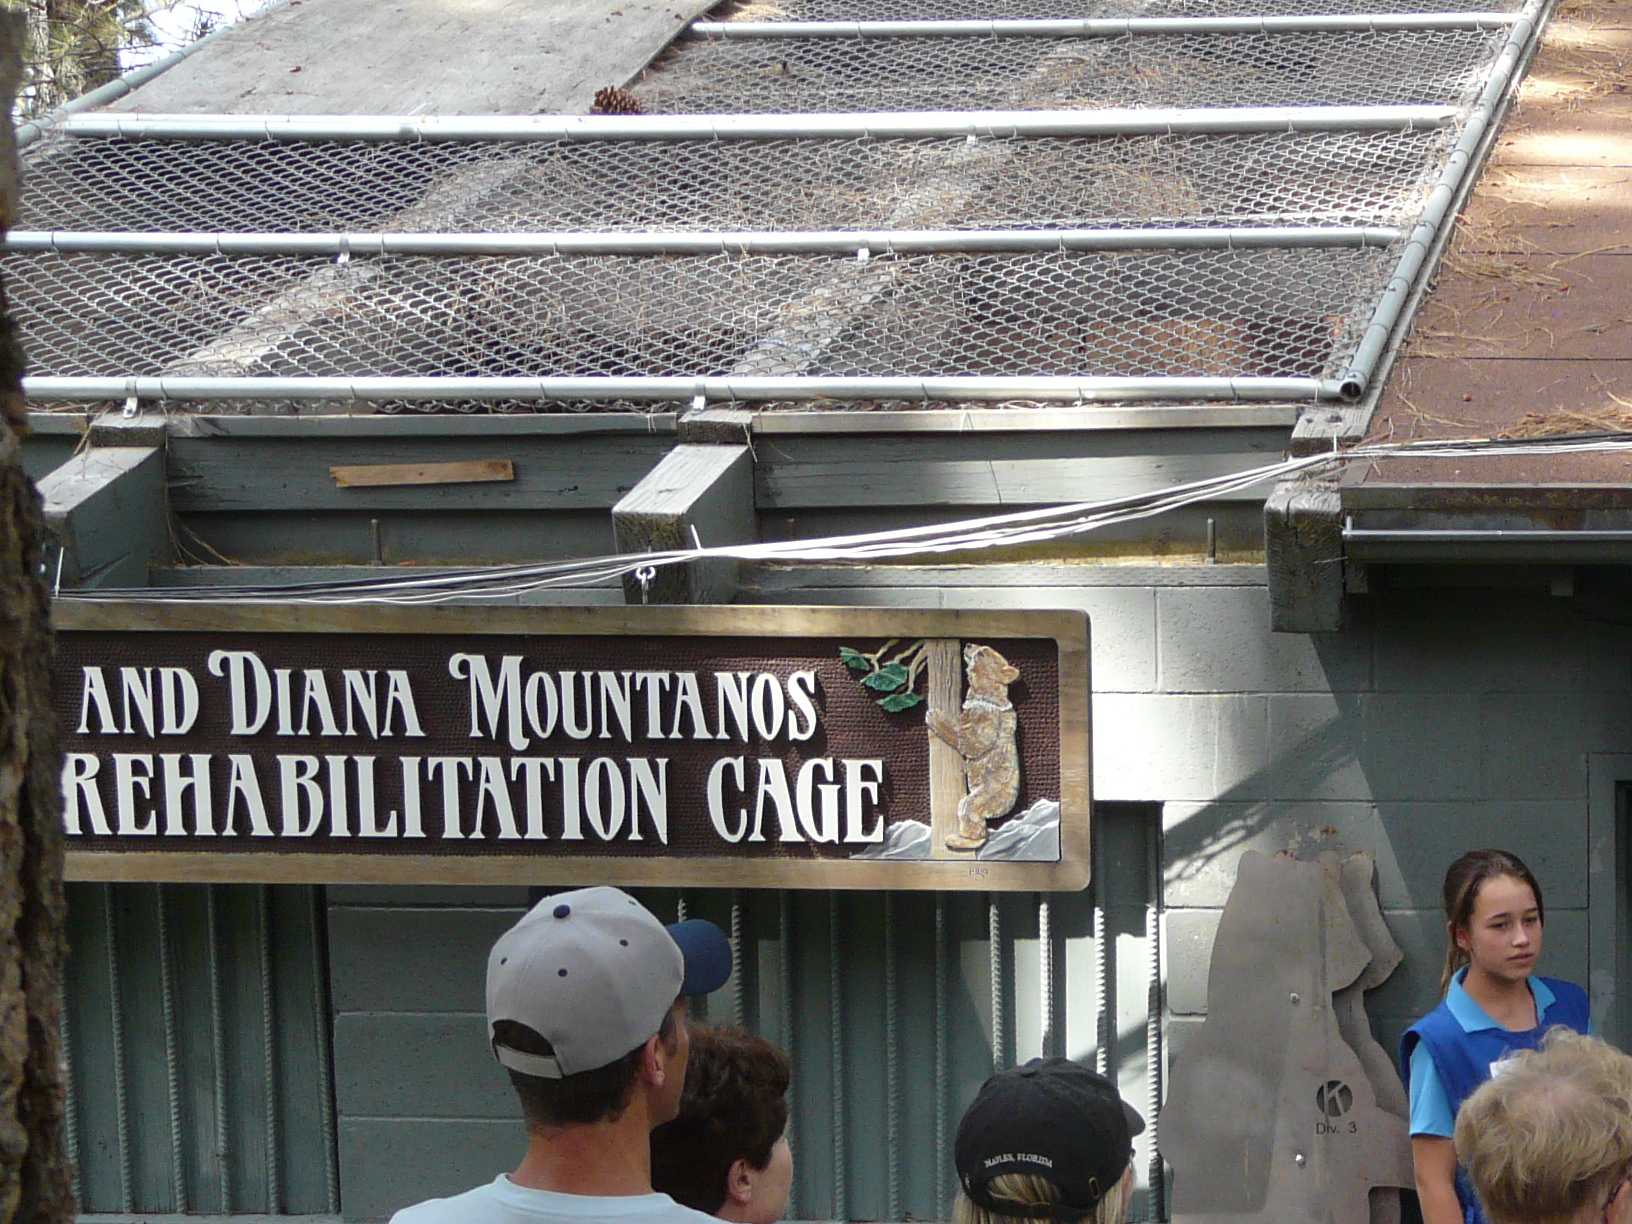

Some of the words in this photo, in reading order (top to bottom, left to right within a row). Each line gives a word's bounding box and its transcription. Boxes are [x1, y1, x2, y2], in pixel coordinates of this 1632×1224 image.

[76, 665, 200, 740] AND
[208, 649, 427, 741] DIANA
[449, 652, 820, 750] MOUNTANOS
[62, 752, 670, 845] REHABILITATION
[707, 755, 887, 845] CAGE
[1316, 1122, 1341, 1135] Div.
[1348, 1120, 1358, 1134] 3
[984, 1153, 1015, 1168] NAPLES,
[1017, 1153, 1053, 1168] FLORIDA
